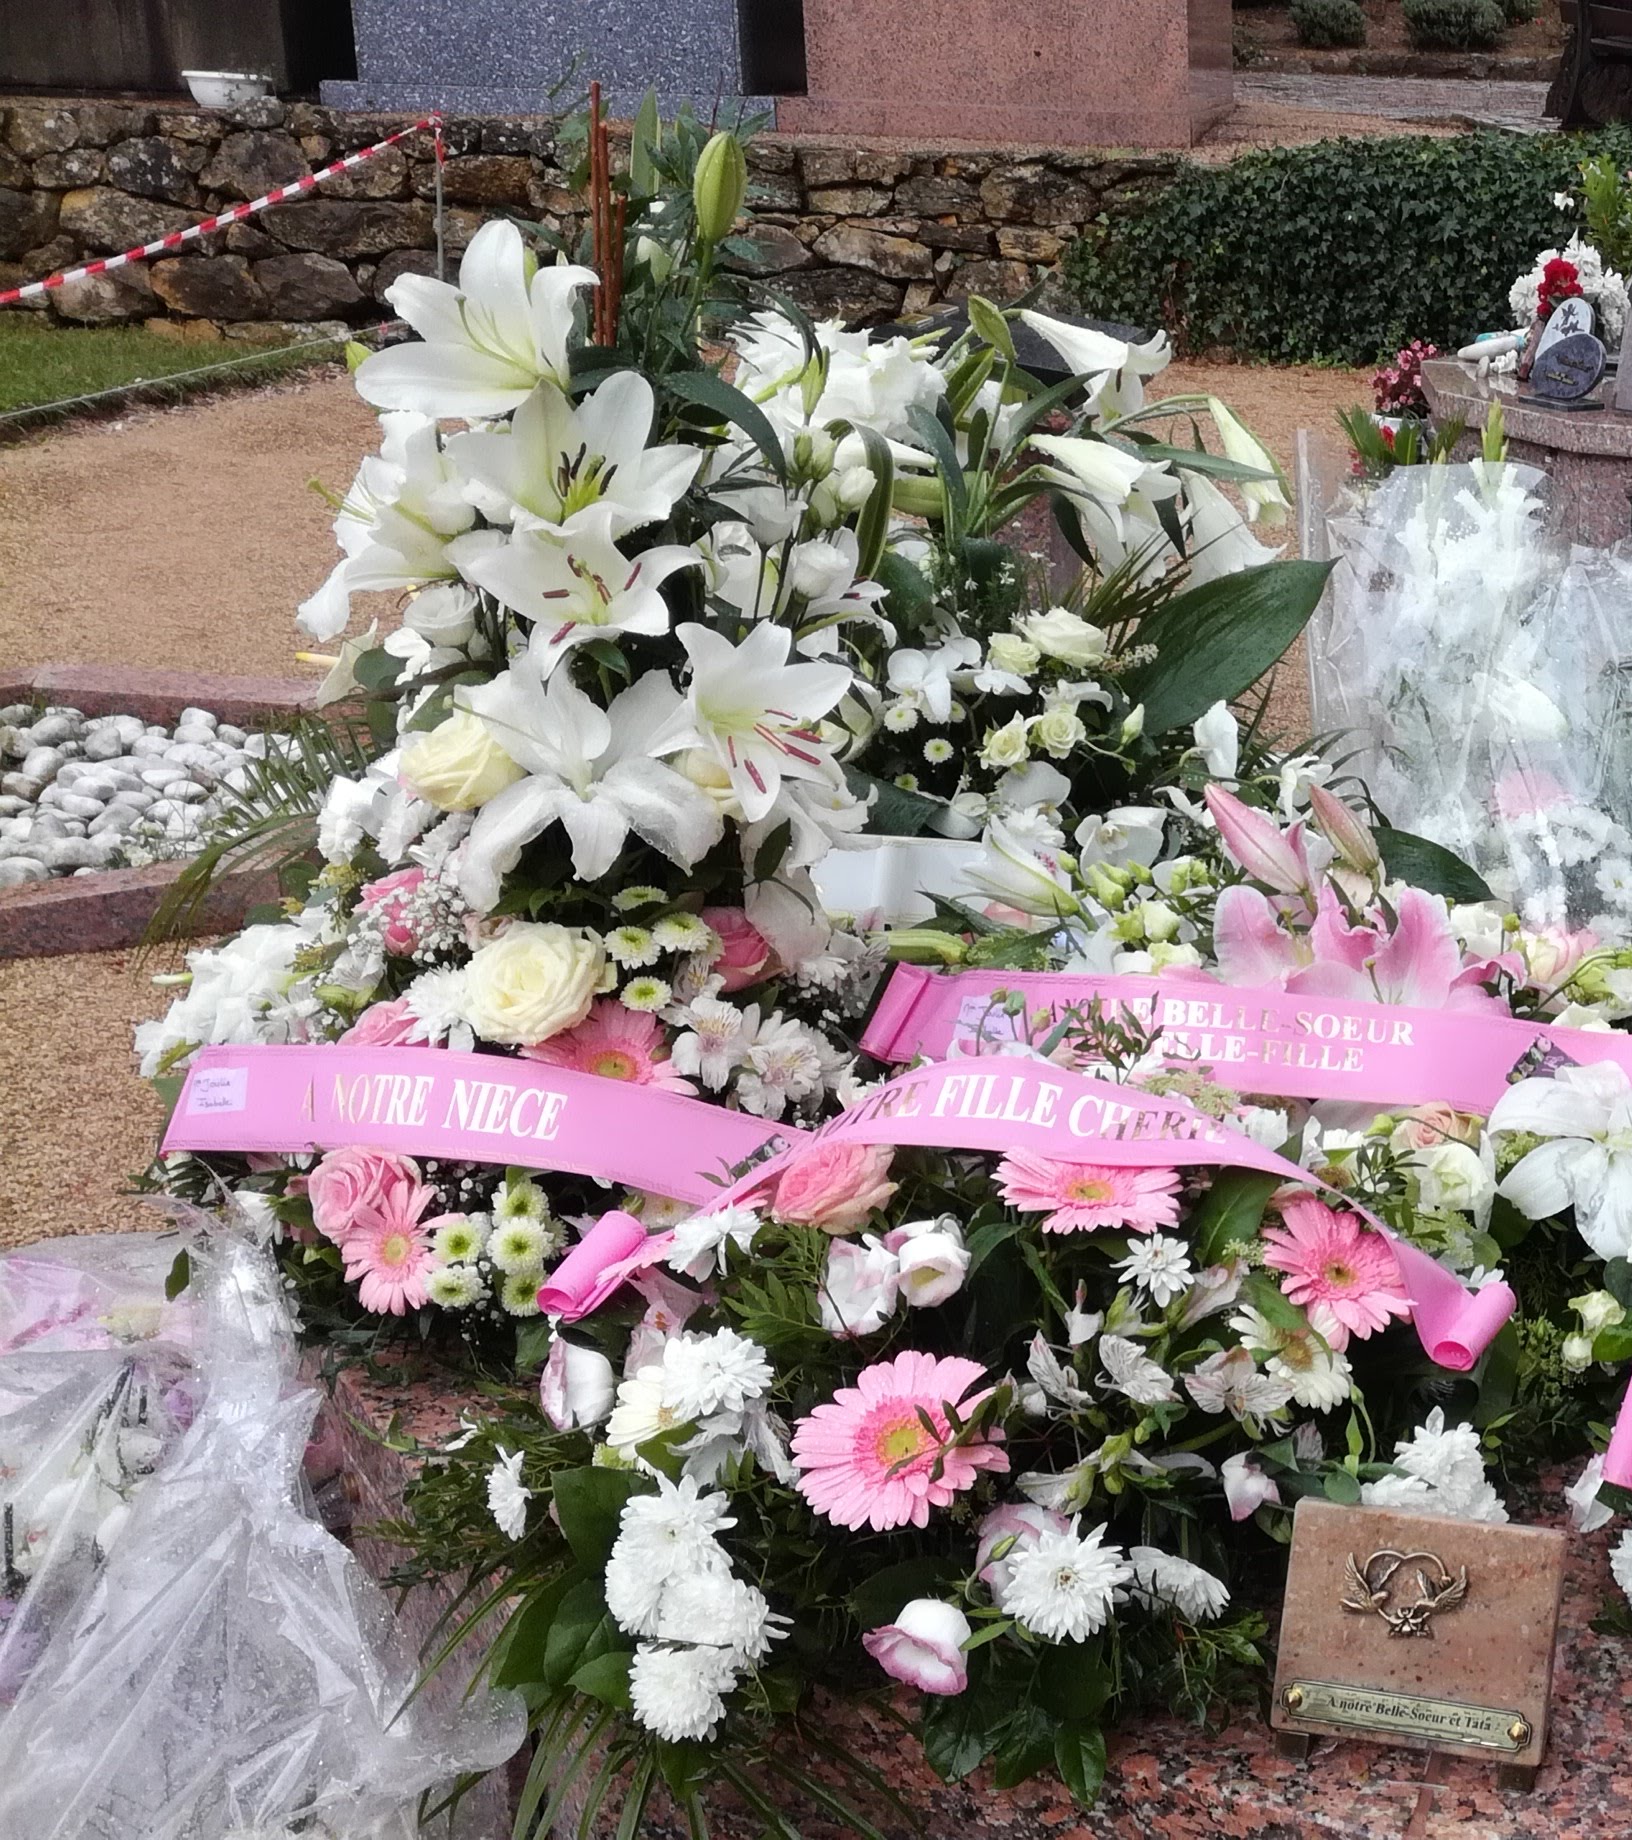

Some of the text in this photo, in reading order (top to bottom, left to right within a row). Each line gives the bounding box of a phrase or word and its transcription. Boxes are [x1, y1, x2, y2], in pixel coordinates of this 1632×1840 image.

[1163, 998, 1415, 1047] BELLE-SOEUR
[1153, 1030, 1365, 1072] ELLE-FILLE
[302, 1073, 569, 1141] A NOTRE NIECE
[929, 1074, 1064, 1128] FILLE
[1068, 1095, 1227, 1144] CHERIE
[1339, 1700, 1373, 1712] notre
[1375, 1702, 1449, 1724] Belle-Soeur
[1449, 1715, 1461, 1727] et
